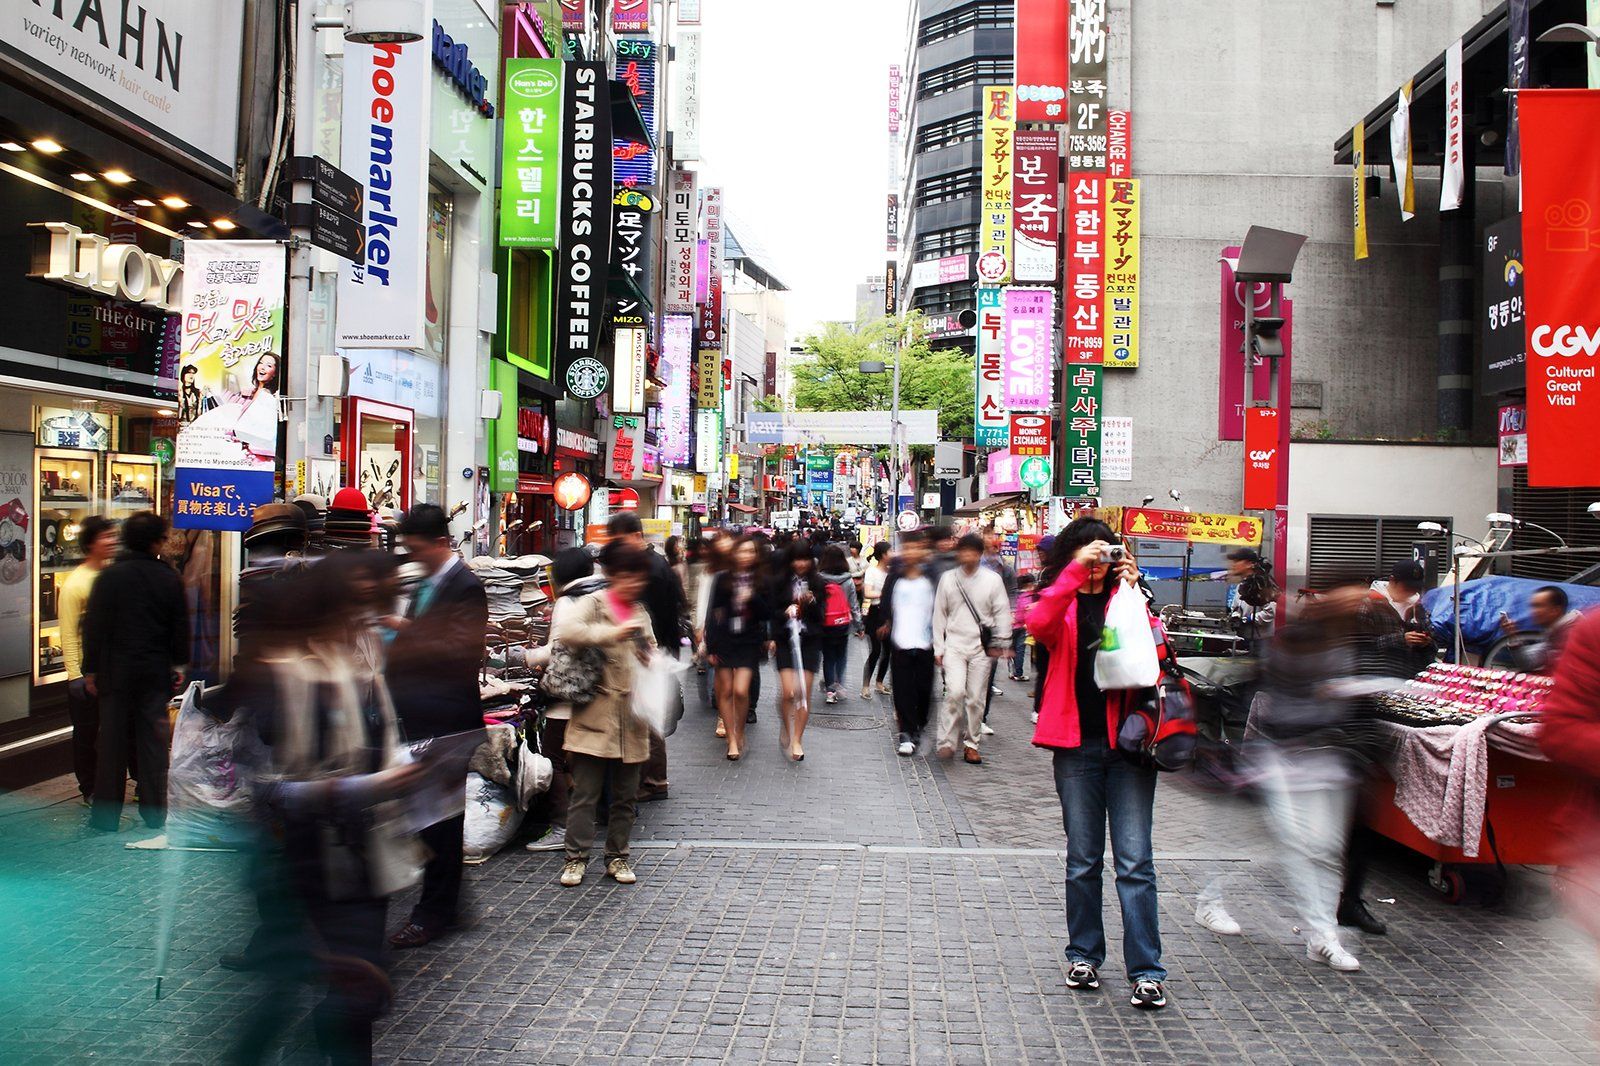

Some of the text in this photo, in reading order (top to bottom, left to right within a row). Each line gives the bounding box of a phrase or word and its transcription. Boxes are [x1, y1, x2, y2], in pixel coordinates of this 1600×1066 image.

[619, 40, 651, 59] Sky
[23, 17, 172, 115] variety network hair castle
[536, 79, 553, 88] Deli
[1077, 103, 1100, 130] 2F
[1069, 135, 1106, 152] 755-3562
[516, 107, 548, 225] 한스델리
[1070, 155, 1106, 168] 명동점
[1110, 163, 1124, 176] 1F
[570, 67, 596, 350] STARBUCKS COFFEE
[674, 193, 692, 303] 미토모 성형외과
[1488, 236, 1498, 253] 8F
[1072, 179, 1101, 331] 신한부동산
[1106, 273, 1136, 284] 컨디션
[93, 306, 156, 335] THE GIFT
[1488, 296, 1526, 331] 명동안
[1112, 298, 1132, 347] 발관리
[342, 332, 411, 342] www.shoemarker.co.kr
[1068, 335, 1103, 349] 771-8959
[1531, 325, 1600, 357] CGV
[1009, 319, 1035, 396] LOVE
[1079, 351, 1094, 361] 3F
[1114, 350, 1128, 358] 4F
[569, 359, 605, 378] STARBUCKS
[1546, 366, 1596, 378] Cultural
[572, 385, 599, 397] COFFEE
[1546, 381, 1582, 392] Great
[1547, 395, 1577, 406] Vital
[986, 437, 1009, 445] 8959
[1013, 436, 1047, 445] EXCHANGE
[1250, 450, 1271, 460] CGV
[0, 472, 28, 486] OLOR
